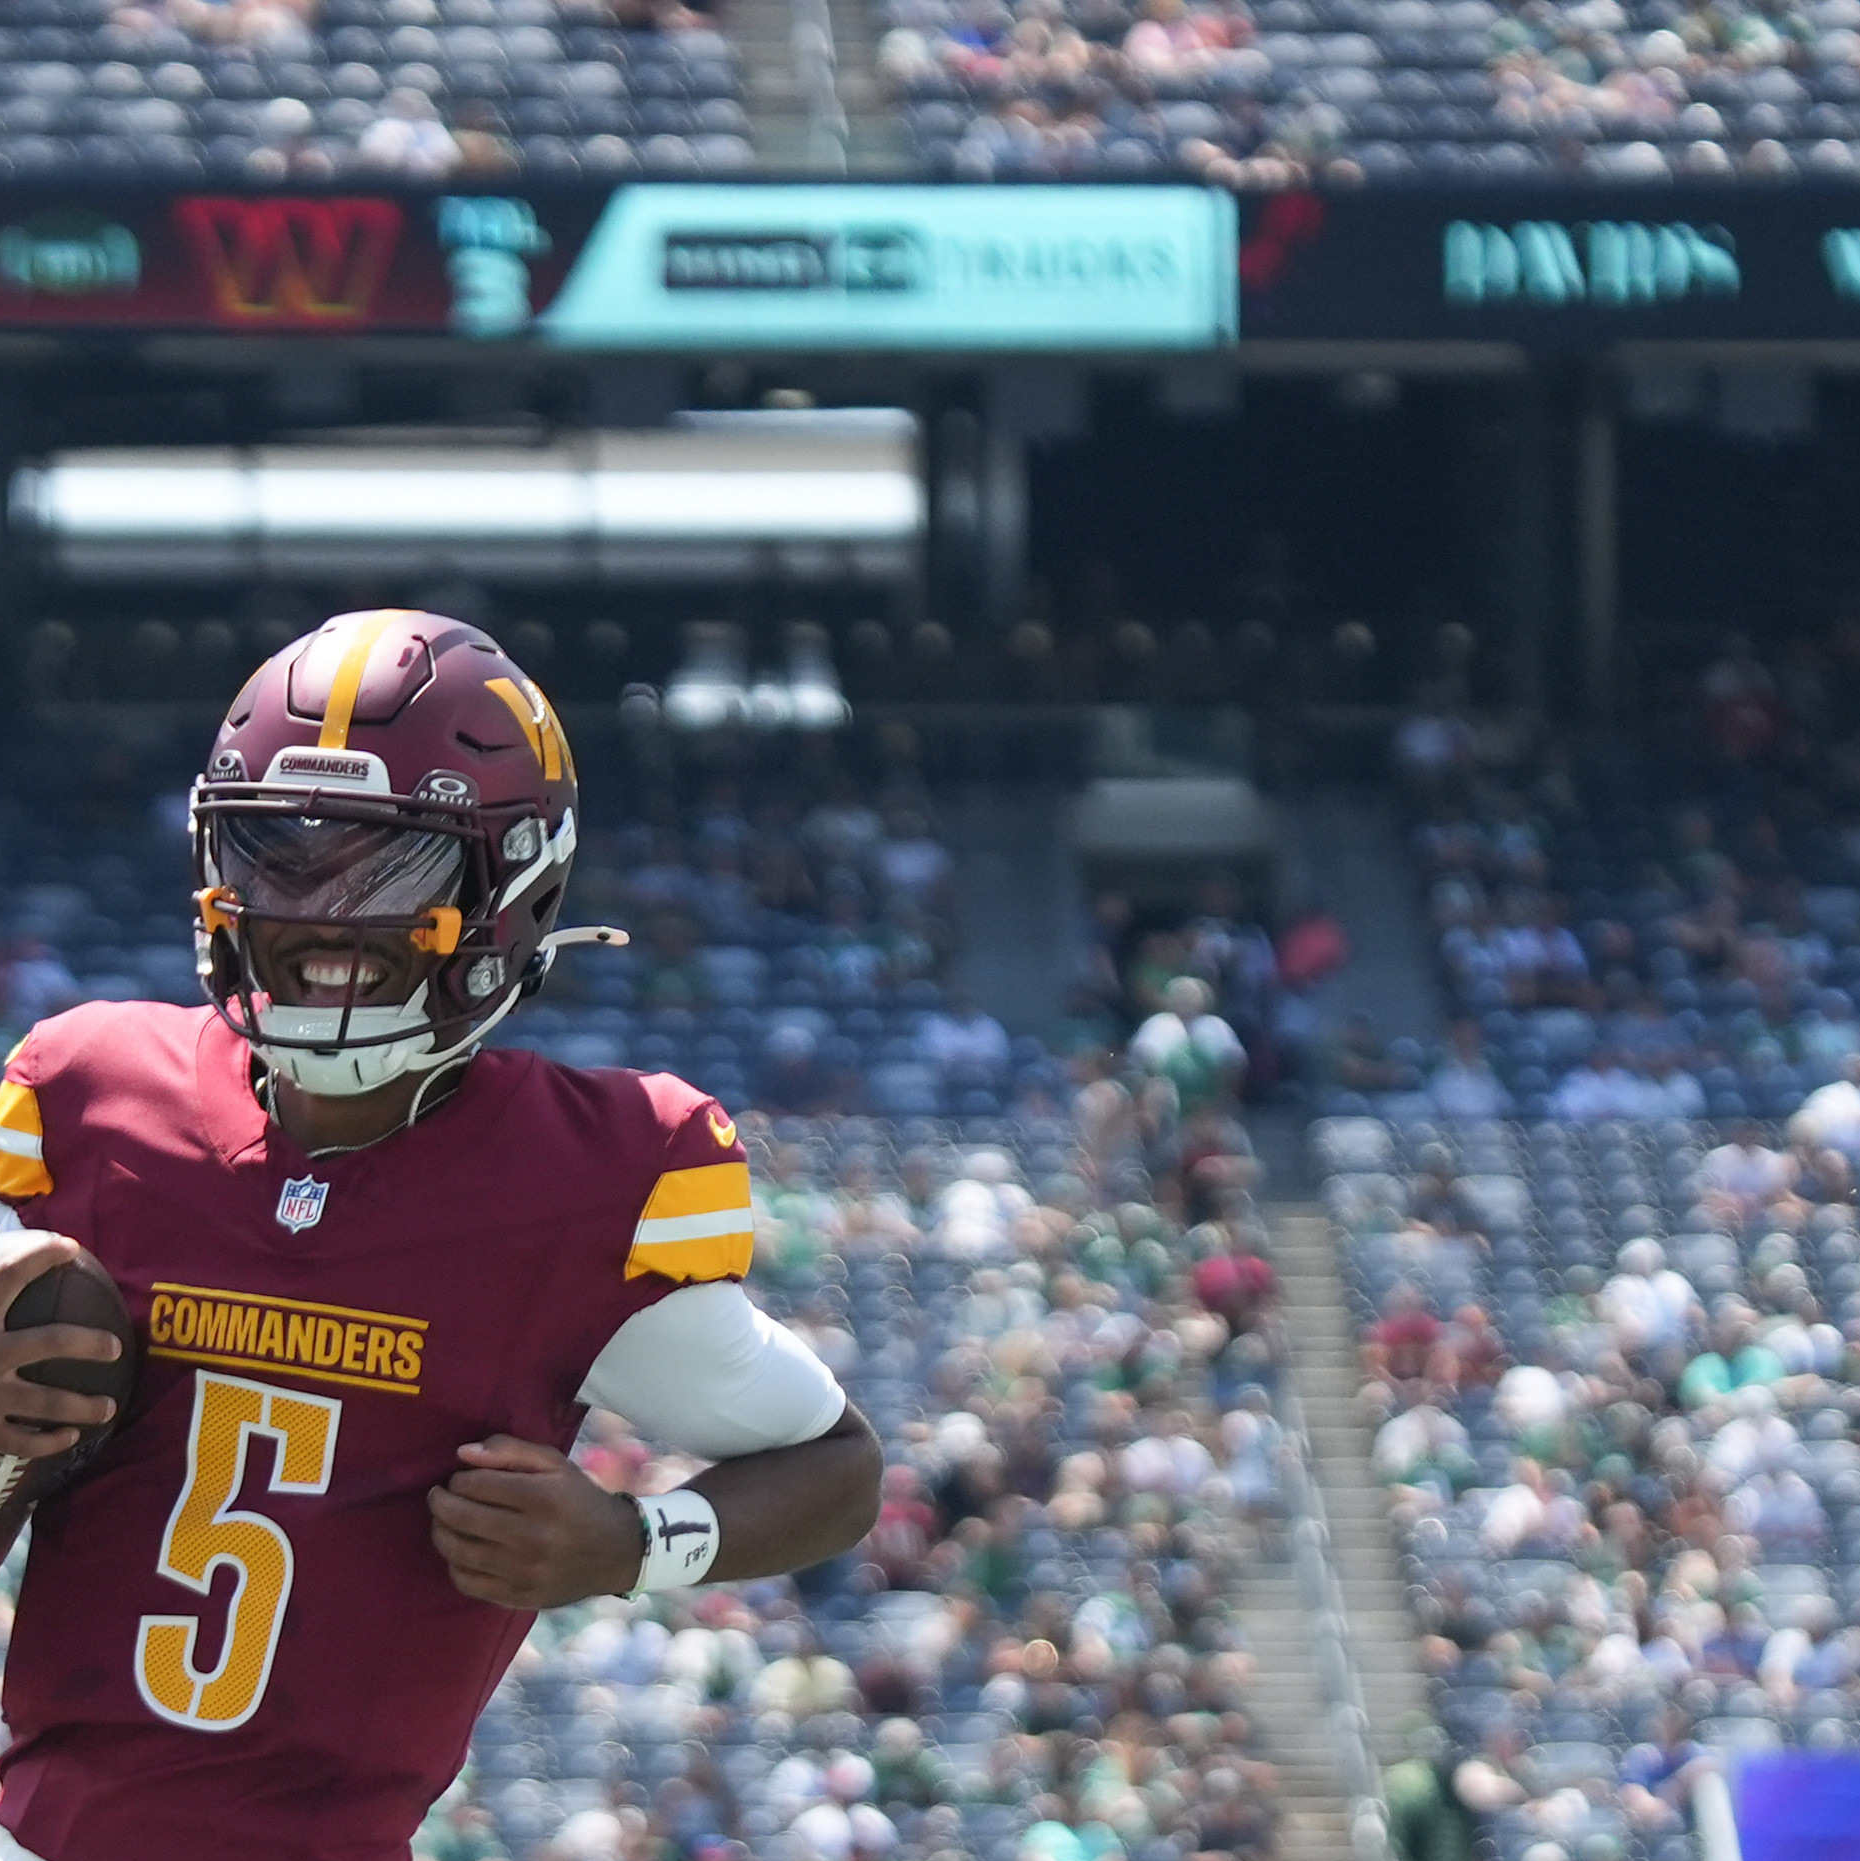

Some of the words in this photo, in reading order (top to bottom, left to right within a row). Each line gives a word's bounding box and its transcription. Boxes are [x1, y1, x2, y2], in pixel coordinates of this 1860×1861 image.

[280, 756, 369, 776] COMMANDERS
[284, 1198, 314, 1221] NFL
[151, 1294, 425, 1379] COMMANDERS
[135, 1369, 343, 1734] 5
